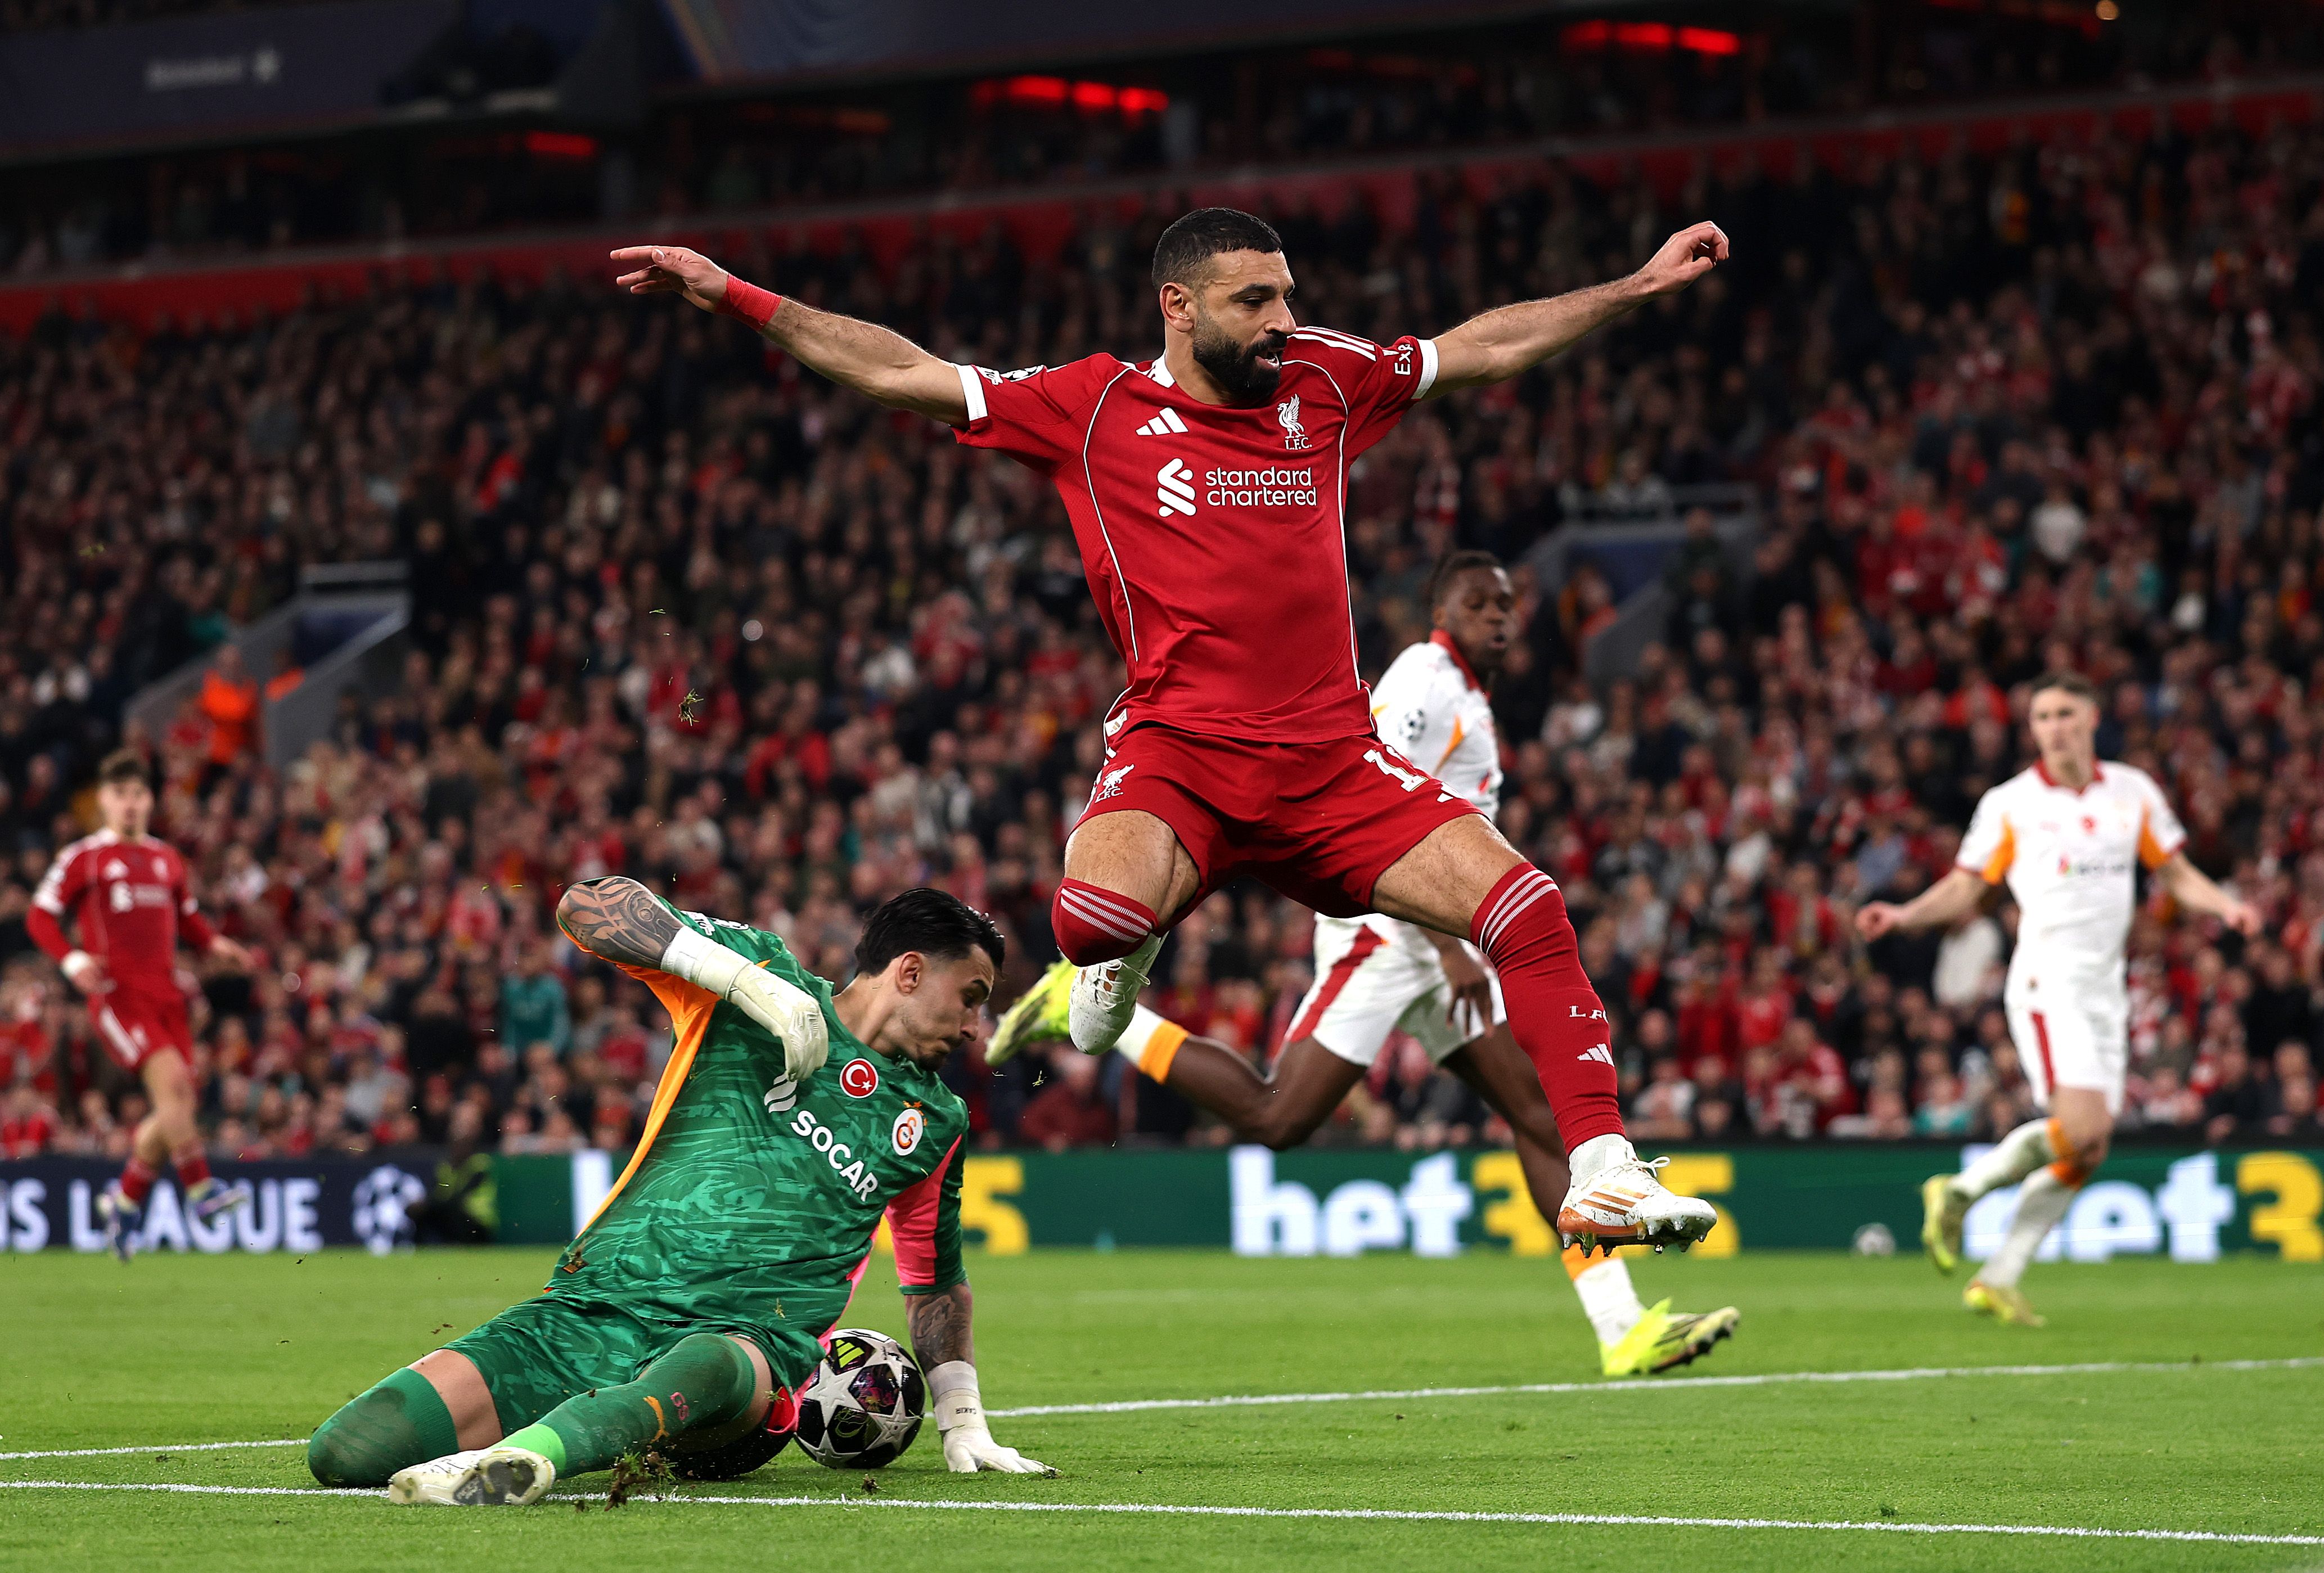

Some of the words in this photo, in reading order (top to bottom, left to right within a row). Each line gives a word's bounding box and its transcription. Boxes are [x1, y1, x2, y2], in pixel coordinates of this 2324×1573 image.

[1205, 466, 1312, 486] standard
[1206, 486, 1317, 506] chartered
[790, 1110, 879, 1202] SOCAR
[67, 1177, 325, 1254] LAGUE
[1229, 1143, 1739, 1258] bet35
